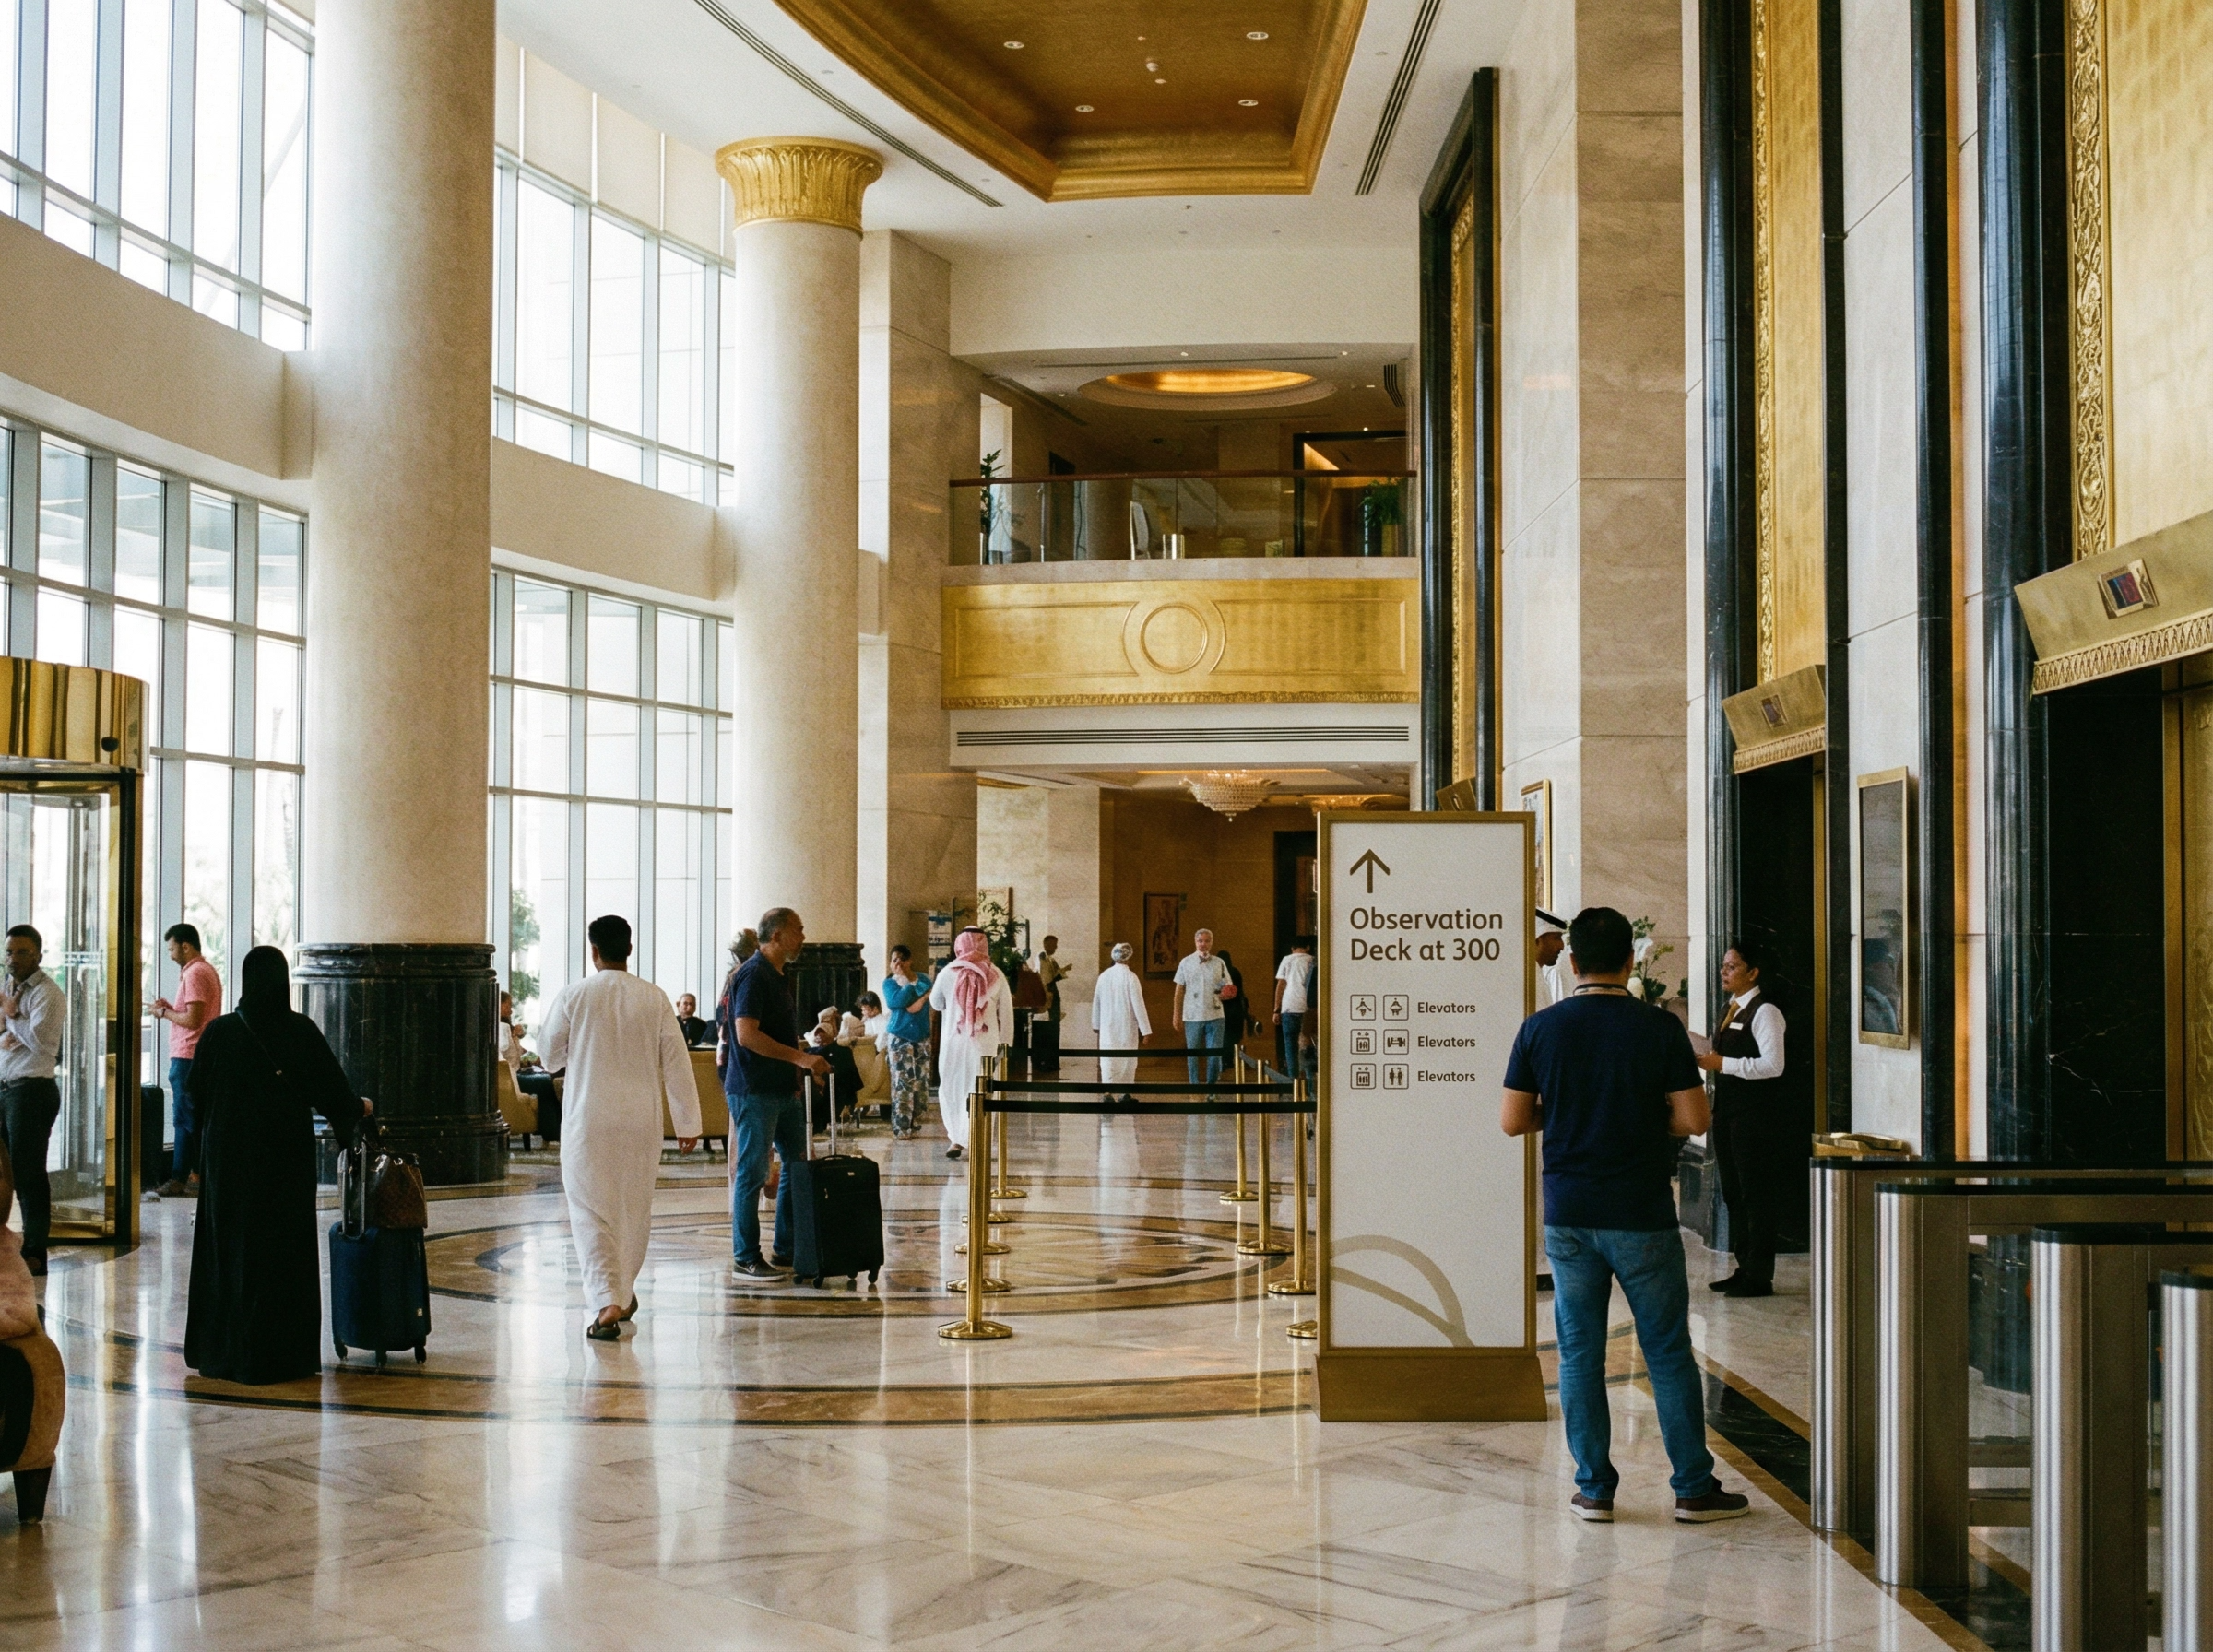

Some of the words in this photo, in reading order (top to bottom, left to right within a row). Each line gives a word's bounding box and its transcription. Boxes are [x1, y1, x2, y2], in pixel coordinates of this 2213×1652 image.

[1349, 906, 1503, 930] Observation
[1351, 937, 1412, 961] Deck
[1419, 939, 1446, 961] at
[1452, 938, 1501, 961] 300
[1417, 1001, 1476, 1014] Elevators
[1417, 1035, 1476, 1048] Elevators
[1417, 1069, 1476, 1082] Elevators
